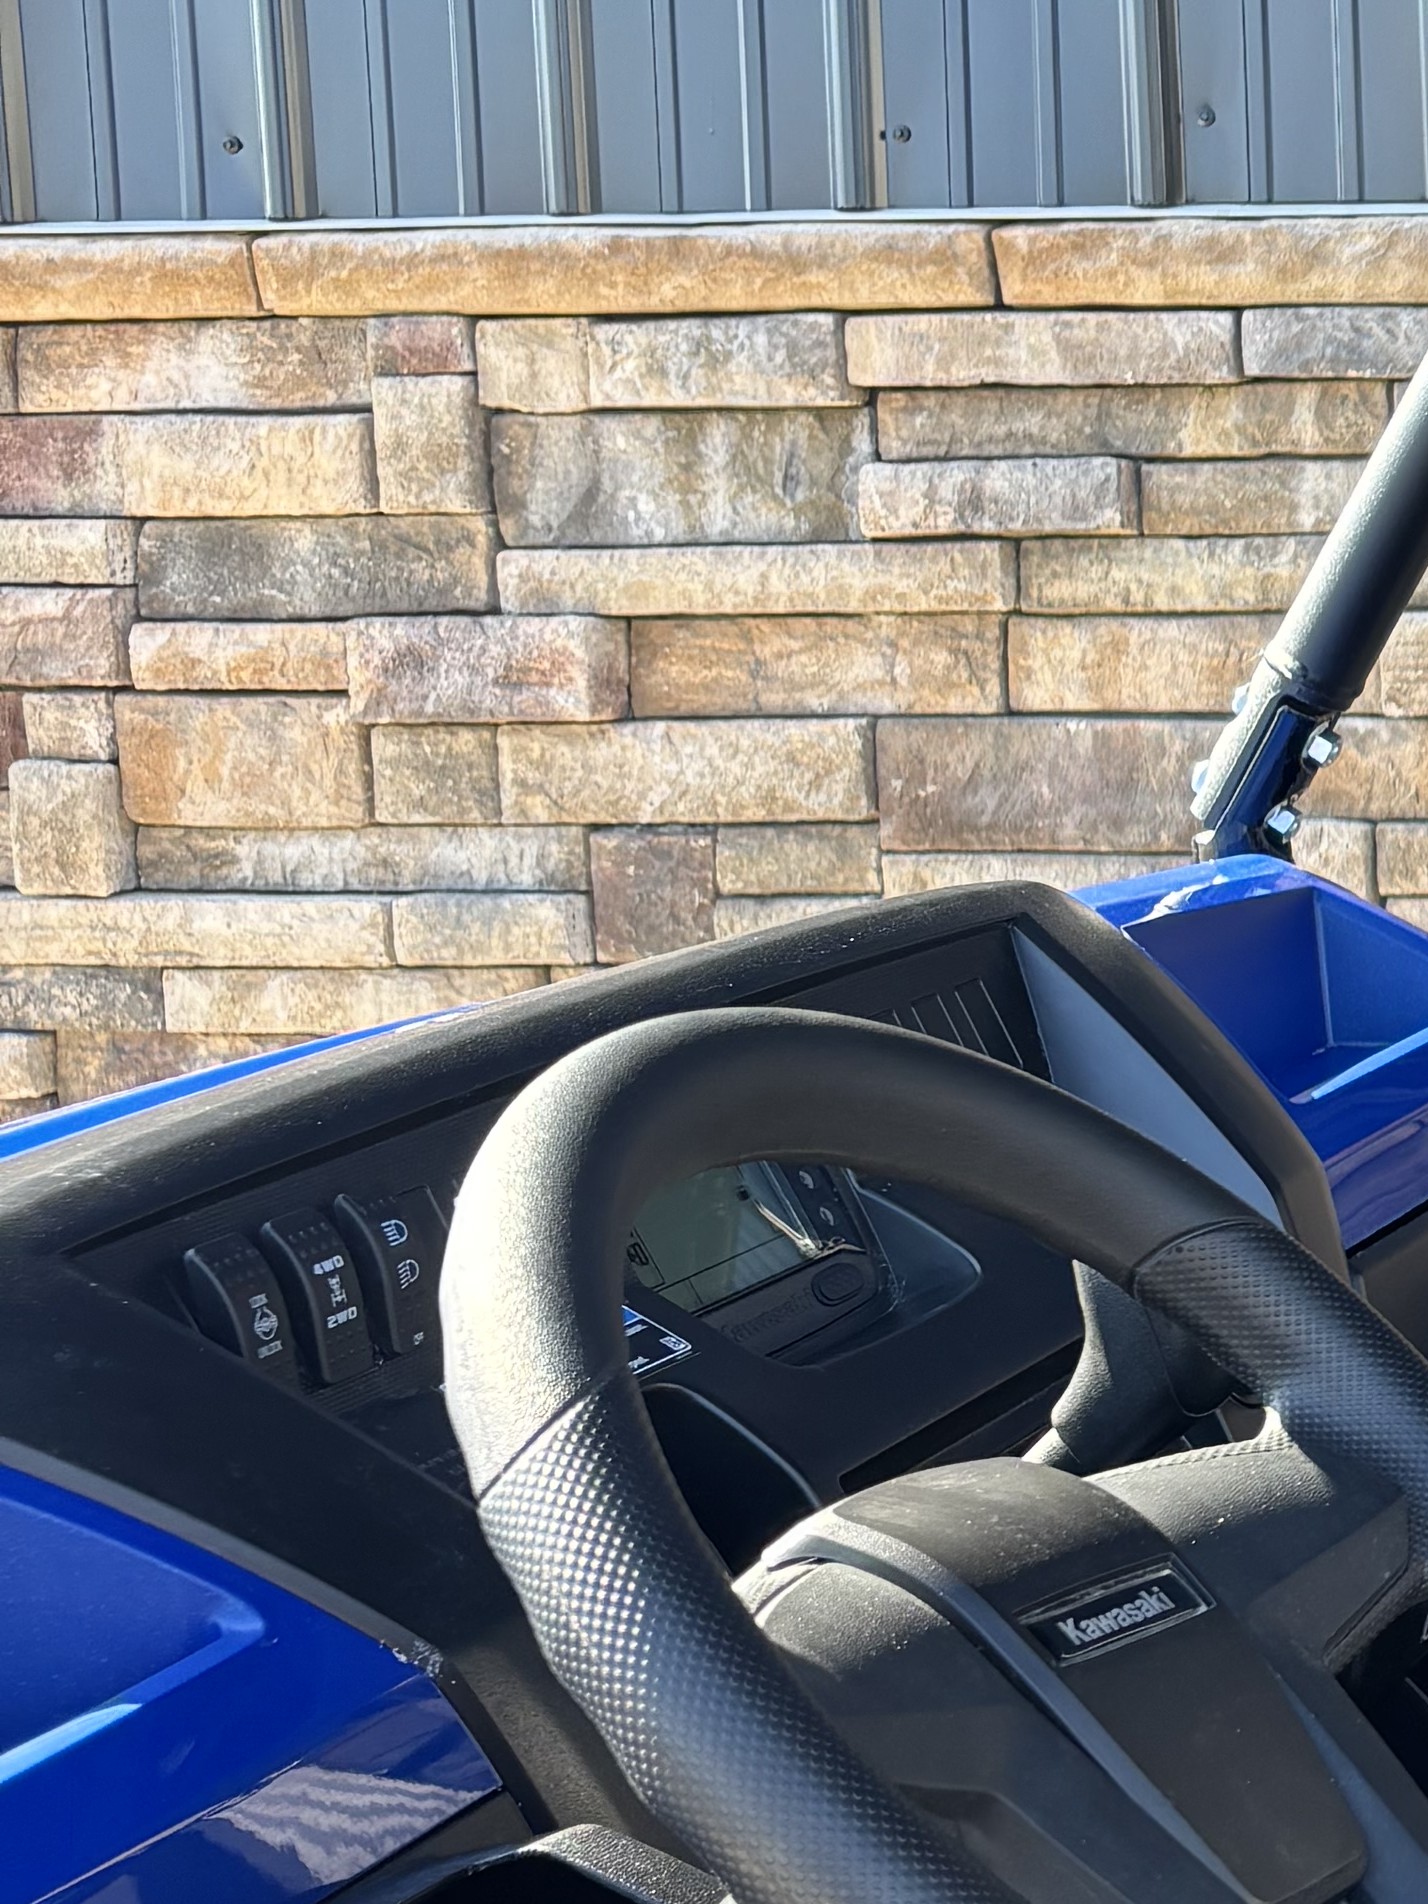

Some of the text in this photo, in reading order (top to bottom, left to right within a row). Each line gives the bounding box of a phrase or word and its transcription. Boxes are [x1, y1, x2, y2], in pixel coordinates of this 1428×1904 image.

[313, 1254, 345, 1275] 4WD
[326, 1305, 358, 1329] 2WD
[1056, 1585, 1176, 1646] Kawasaki
